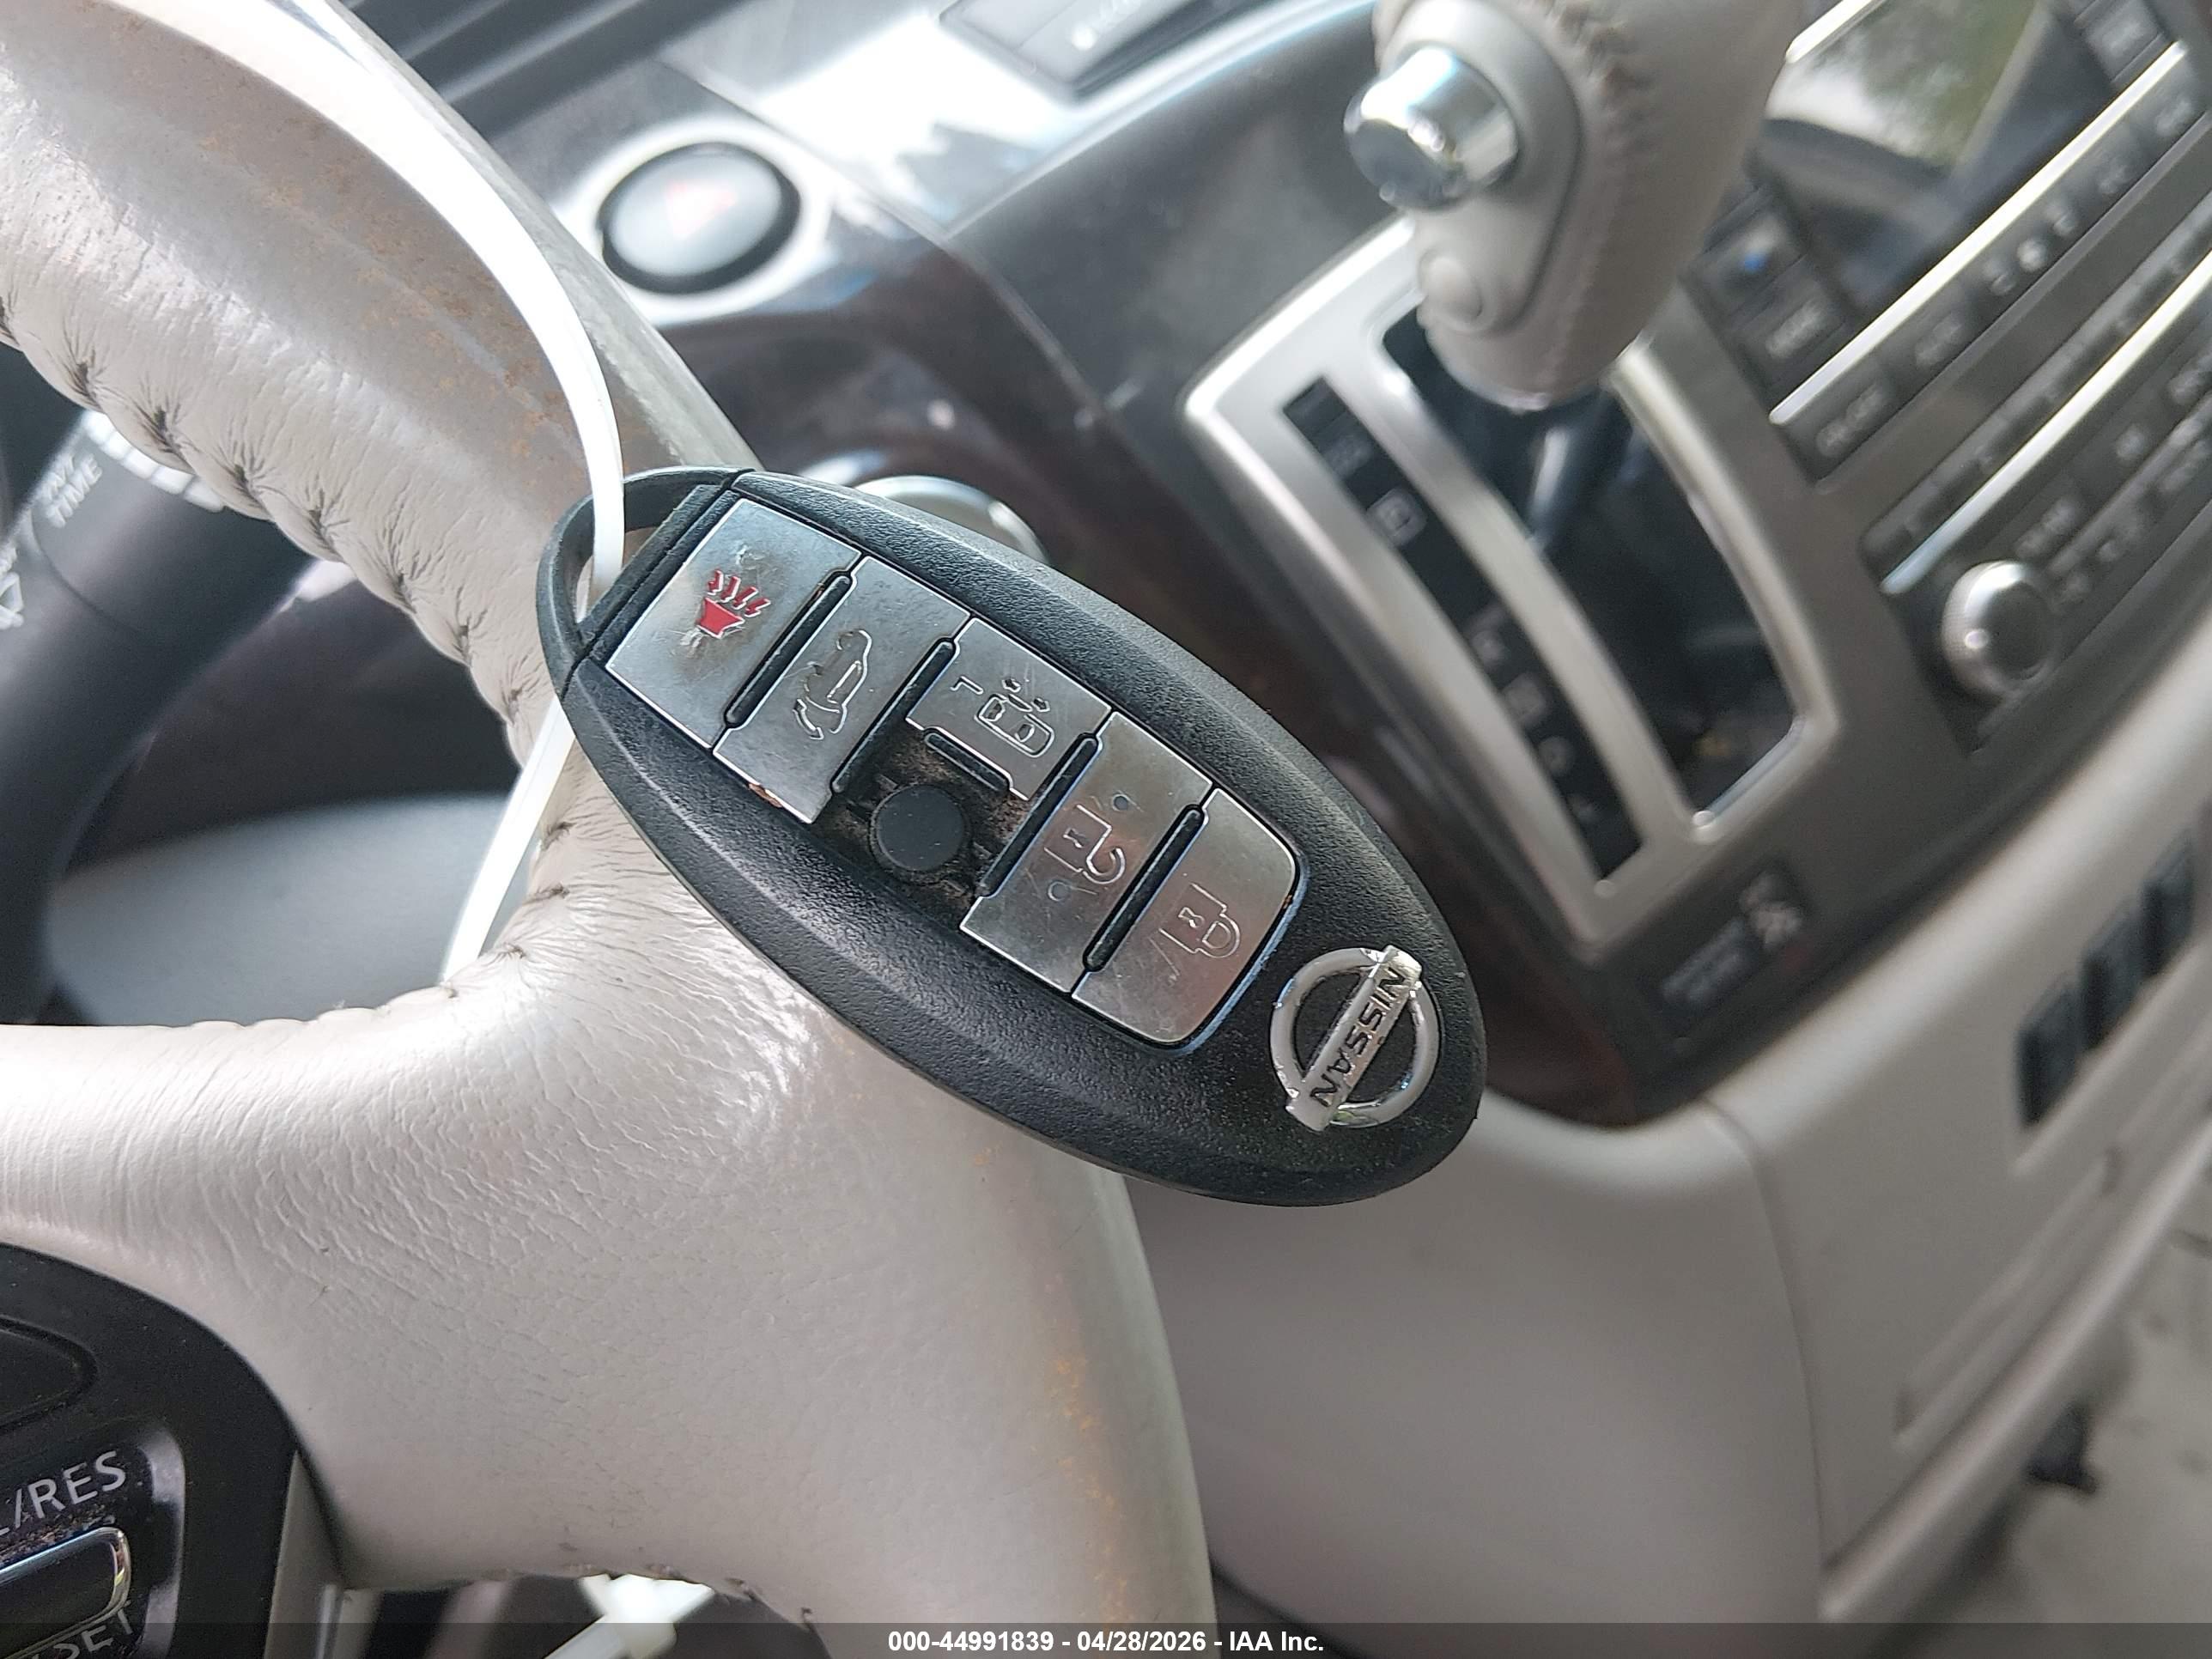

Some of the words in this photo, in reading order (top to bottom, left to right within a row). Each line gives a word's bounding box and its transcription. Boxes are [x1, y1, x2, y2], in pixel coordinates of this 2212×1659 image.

[45, 453, 103, 528] TIME
[1310, 967, 1406, 1107] NISSAN
[0, 1450, 127, 1536] /RES
